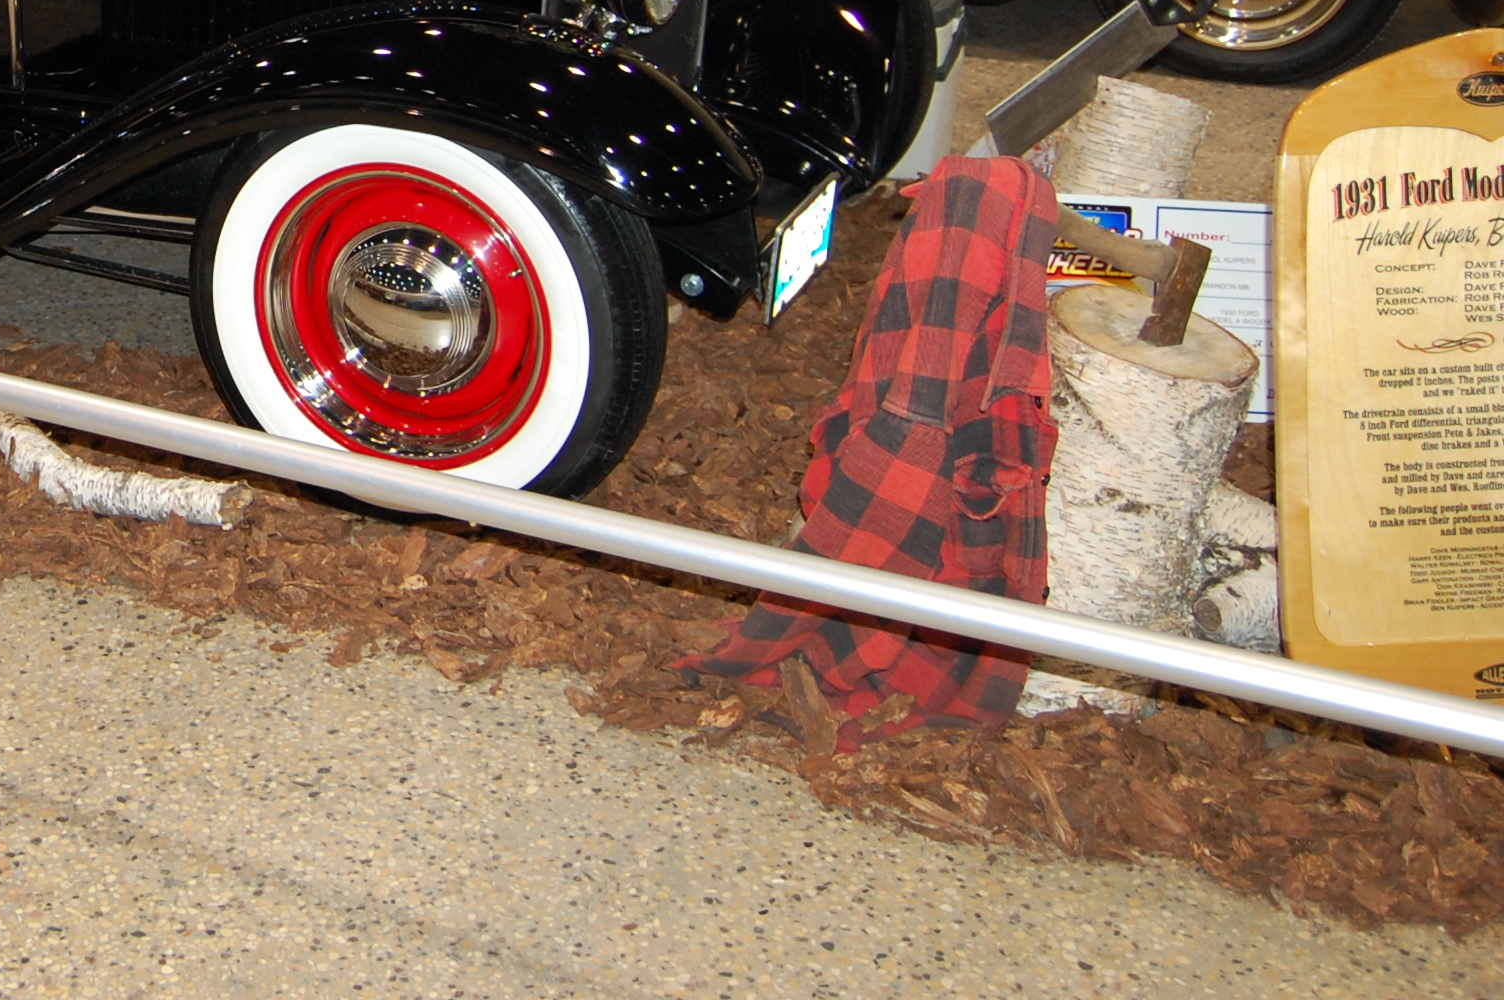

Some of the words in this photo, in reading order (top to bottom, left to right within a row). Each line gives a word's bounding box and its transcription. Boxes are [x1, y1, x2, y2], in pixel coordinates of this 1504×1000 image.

[1331, 175, 1390, 223] 1931
[1399, 166, 1455, 209] Ford
[1460, 164, 1504, 203] Mod
[1164, 229, 1231, 243] Number:
[1355, 220, 1419, 256] Harold
[1417, 217, 1480, 257] Kuipers,
[1046, 253, 1134, 278] HEEL
[1223, 256, 1256, 264] KUIPERS
[1363, 368, 1380, 377] The
[1399, 366, 1415, 376] sits
[1431, 366, 1437, 374] a
[1439, 364, 1471, 374] custom
[1473, 362, 1493, 373] built
[1378, 377, 1414, 389] dropped
[1424, 375, 1455, 386] inches.
[1458, 374, 1474, 384] The
[1476, 374, 1500, 385] posts
[1423, 387, 1439, 397] and
[1441, 387, 1454, 397] we
[1342, 410, 1359, 419] The
[1361, 407, 1406, 419] drivetrain
[1407, 405, 1444, 417] consists
[1446, 405, 1455, 415] of
[1456, 405, 1463, 414] a
[1465, 403, 1490, 413] small
[1368, 419, 1387, 430] inch
[1389, 418, 1409, 429] Ford
[1411, 416, 1463, 428] differential,
[1366, 432, 1391, 442] Front
[1392, 430, 1442, 441] suspension
[1444, 428, 1464, 438] Pete
[1466, 428, 1473, 437] &
[1421, 441, 1439, 451] disc
[1441, 439, 1472, 450] brakes
[1474, 438, 1491, 448] and
[1384, 462, 1401, 472] The
[1402, 461, 1423, 472] body
[1425, 461, 1433, 470] is
[1435, 458, 1487, 470] constructed
[1381, 474, 1398, 484] and
[1400, 472, 1427, 483] milled
[1430, 472, 1441, 483] by
[1443, 471, 1464, 480] Dave
[1466, 470, 1483, 480] and
[1393, 485, 1404, 496] by
[1406, 484, 1428, 494] Dave
[1430, 483, 1447, 493] and
[1449, 482, 1470, 492] Wes.
[1379, 506, 1396, 516] The
[1398, 504, 1438, 515] following
[1440, 502, 1468, 514] people
[1470, 502, 1492, 511] went
[1368, 519, 1378, 528] to
[1380, 517, 1405, 527] make
[1407, 517, 1427, 526] sure
[1429, 515, 1450, 525] their
[1451, 514, 1491, 526] products
[1439, 527, 1457, 536] and
[1459, 526, 1473, 536] the
